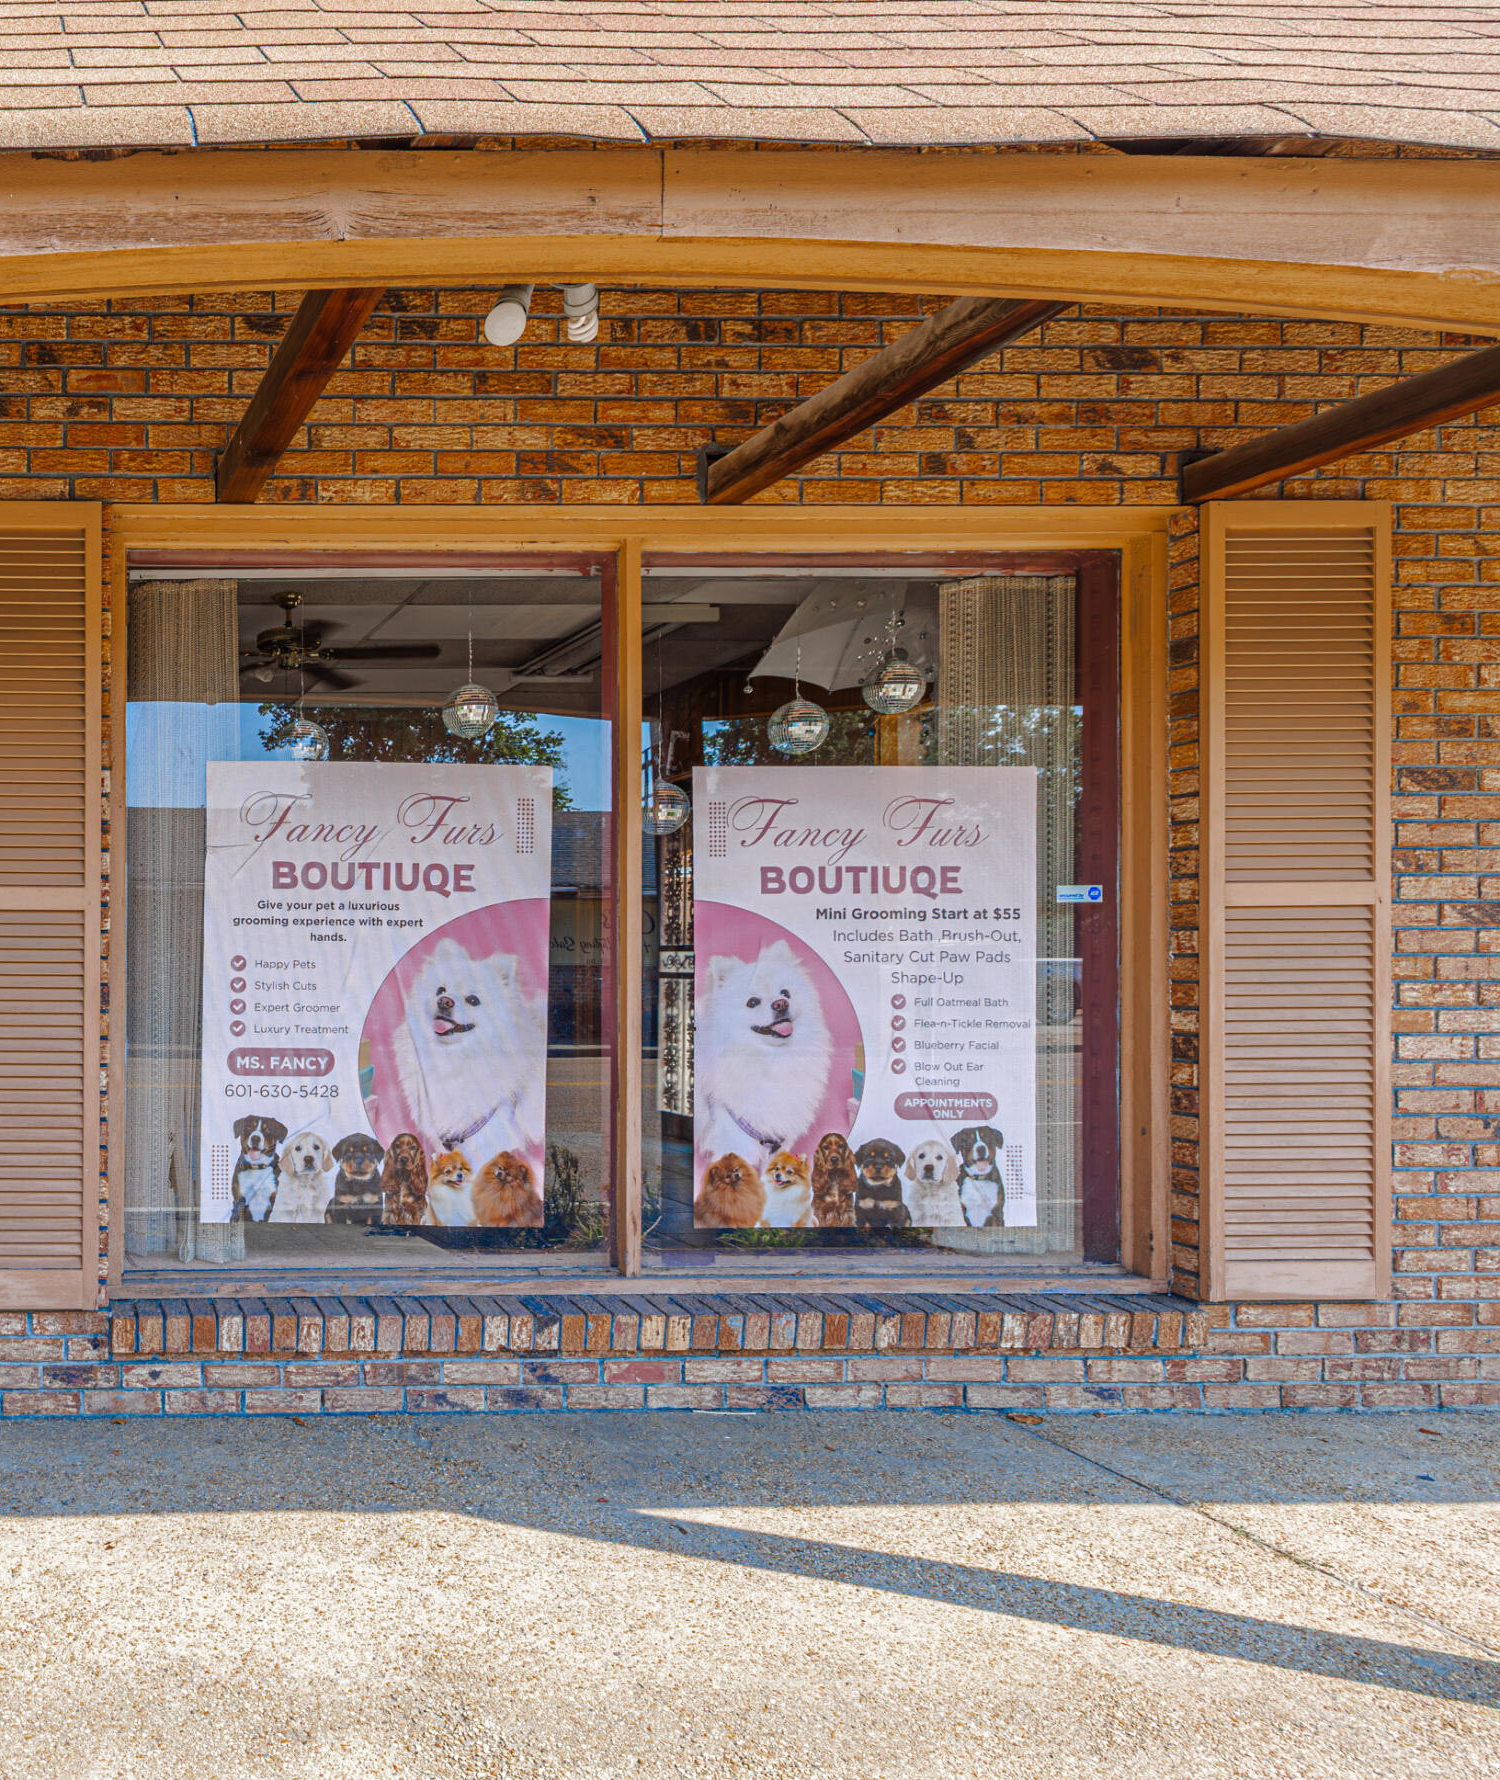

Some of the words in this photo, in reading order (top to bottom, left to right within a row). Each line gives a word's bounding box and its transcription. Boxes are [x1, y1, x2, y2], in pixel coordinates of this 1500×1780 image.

[239, 790, 380, 862] Fancy
[397, 792, 504, 846] Furs
[726, 795, 867, 866] Fancy
[883, 795, 989, 847] Furs
[272, 861, 476, 898] BOUTIUQE
[760, 866, 963, 900] BOUTIUQE
[257, 900, 283, 910] Give
[287, 901, 312, 912] your
[316, 901, 335, 912] pet
[339, 902, 345, 910] a
[348, 901, 400, 911] luxurious
[816, 908, 847, 920] Mini
[852, 908, 927, 922] Grooming
[932, 908, 968, 920] Start
[973, 909, 988, 920] at
[993, 907, 1021, 920] $55
[233, 917, 288, 926] grooming
[293, 917, 354, 927] experience
[359, 917, 383, 926] with
[387, 918, 423, 928] expert
[310, 933, 347, 942] hands.
[833, 930, 894, 942] Includes
[899, 930, 933, 942] Bath
[844, 951, 904, 964] Sanitary
[909, 951, 935, 963] Cut
[940, 951, 970, 963] Paw
[976, 951, 1011, 963] Pads
[255, 959, 290, 969] Happy
[293, 960, 316, 969] Pets
[891, 972, 964, 985] Shape-Up
[254, 981, 289, 991] Stylish
[293, 981, 317, 990] Cuts
[914, 998, 932, 1007] Full
[936, 998, 981, 1007] Oatmeal
[984, 998, 1009, 1007] Bath
[254, 1003, 290, 1013] Expert
[293, 1003, 340, 1013] Groomer
[914, 1019, 982, 1028] Flea-n-Tickle
[985, 1019, 1031, 1029] Removal
[254, 1025, 290, 1035] Luxury
[294, 1025, 349, 1034] Treatment
[914, 1041, 965, 1051] Blueberry
[969, 1041, 999, 1050] Facial
[236, 1056, 264, 1069] MS.
[270, 1057, 329, 1069] FANCY
[914, 1062, 940, 1071] Blow
[944, 1063, 963, 1071] Out
[967, 1063, 984, 1071] Ear
[915, 1077, 960, 1087] Cleaning
[225, 1084, 339, 1098] 601-630-5428
[904, 1099, 992, 1107] APPOINTMENTS
[933, 1110, 964, 1119] ONLY
